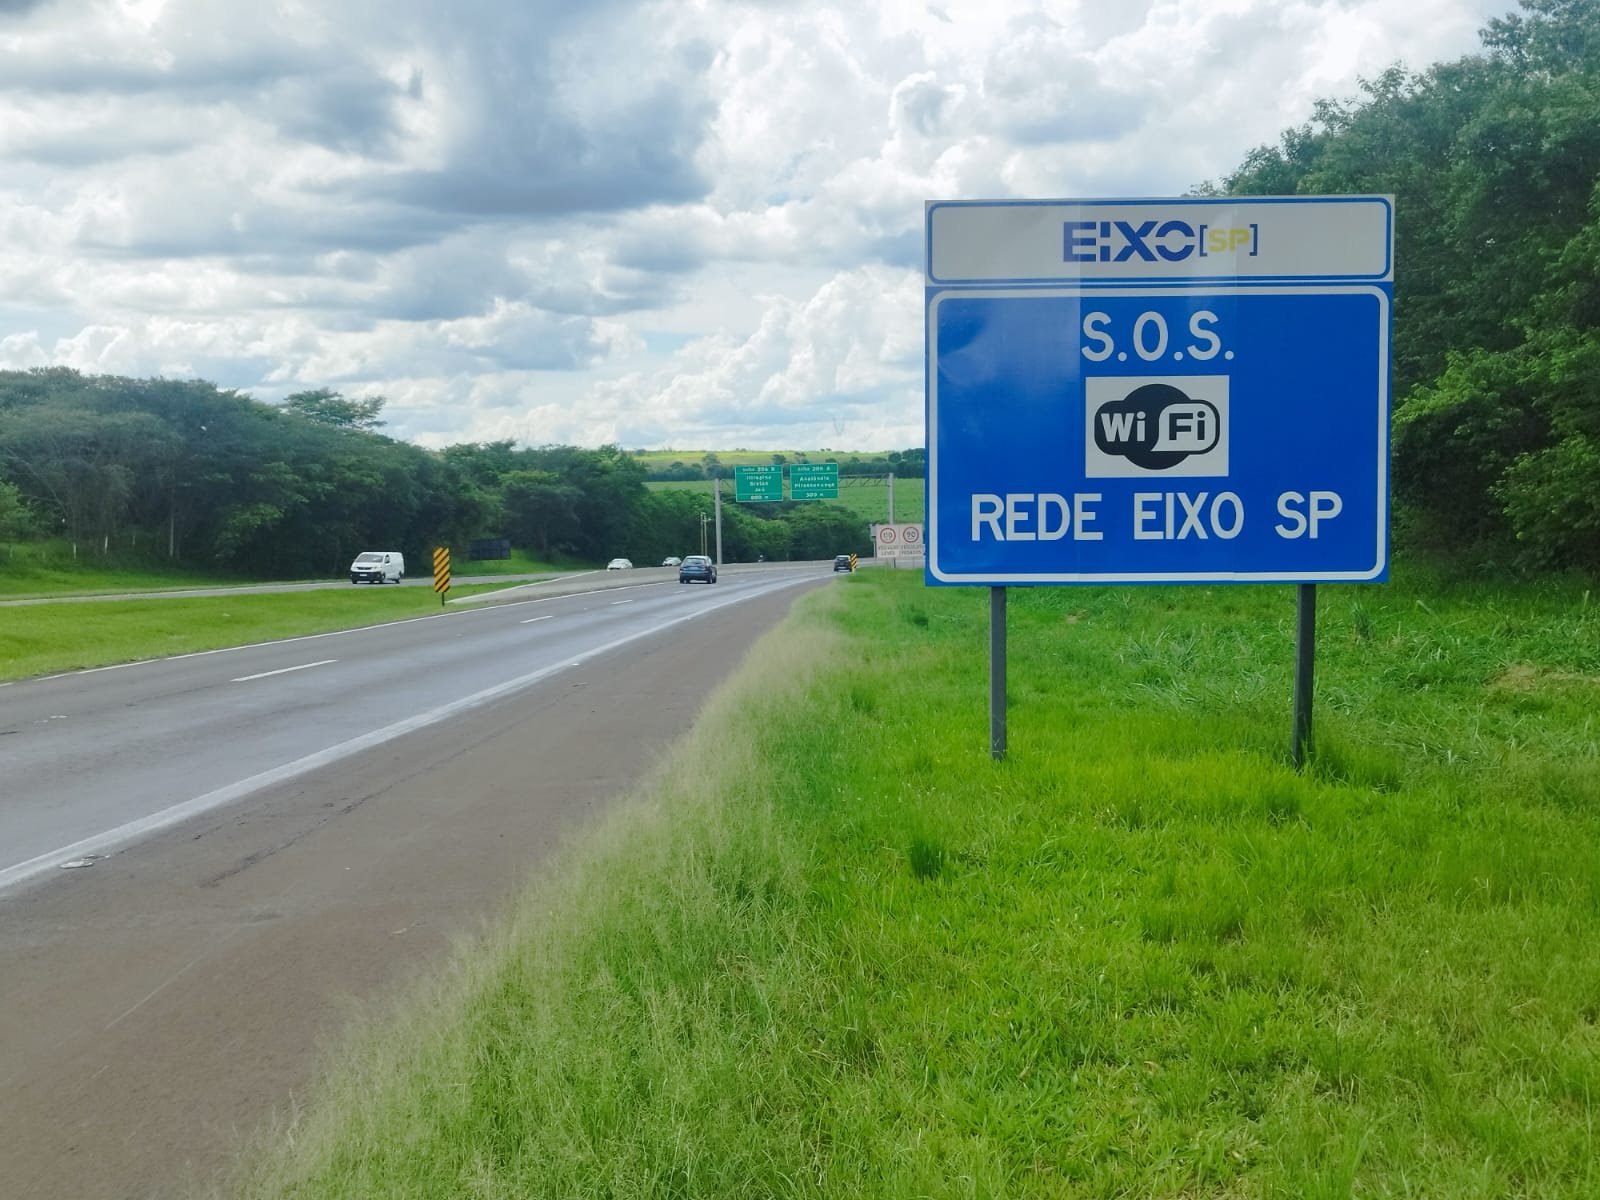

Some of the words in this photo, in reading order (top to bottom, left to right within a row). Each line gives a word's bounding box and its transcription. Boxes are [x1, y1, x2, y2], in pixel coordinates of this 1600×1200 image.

[1081, 310, 1235, 362] S.O.S.
[971, 492, 1104, 542] REDE
[1133, 491, 1245, 541] EIXO
[1274, 490, 1343, 540] SP
